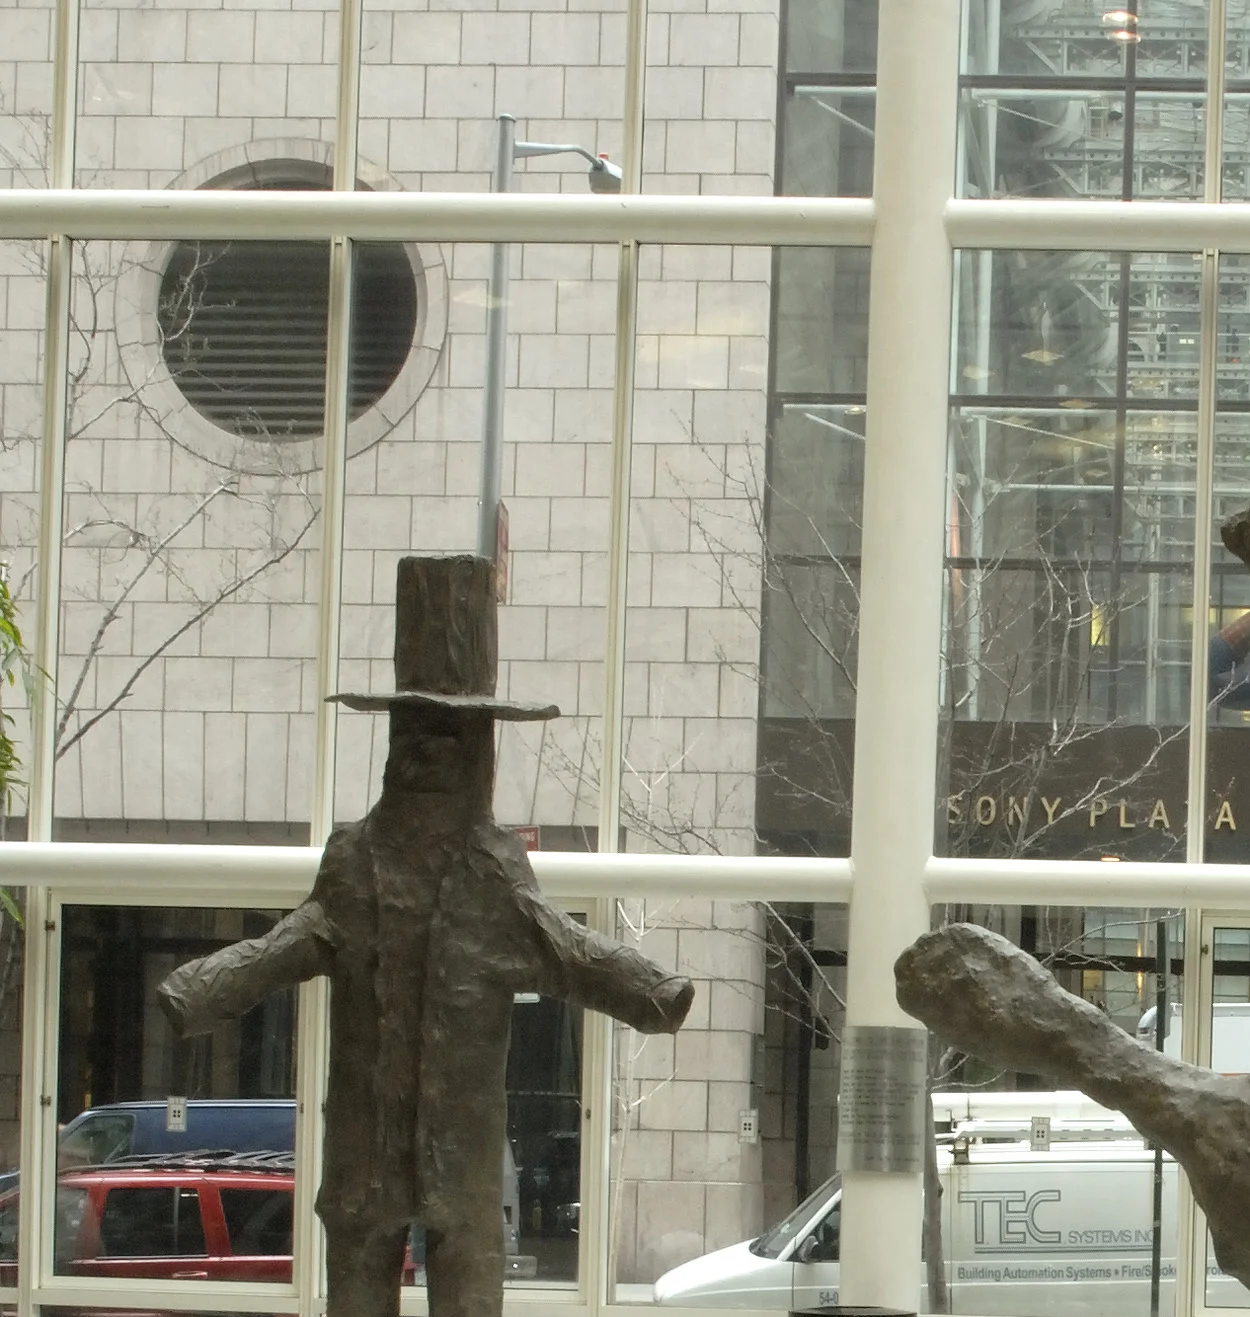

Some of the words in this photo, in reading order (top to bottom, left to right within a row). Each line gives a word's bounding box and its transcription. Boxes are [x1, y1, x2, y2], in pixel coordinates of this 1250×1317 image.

[946, 796, 1061, 825] SONY
[1089, 799, 1237, 830] PLAA
[1067, 1229, 1132, 1244] SYSTEMS
[957, 1266, 1000, 1281] Building
[1002, 1265, 1064, 1279] Automation
[1066, 1265, 1112, 1281] Systems
